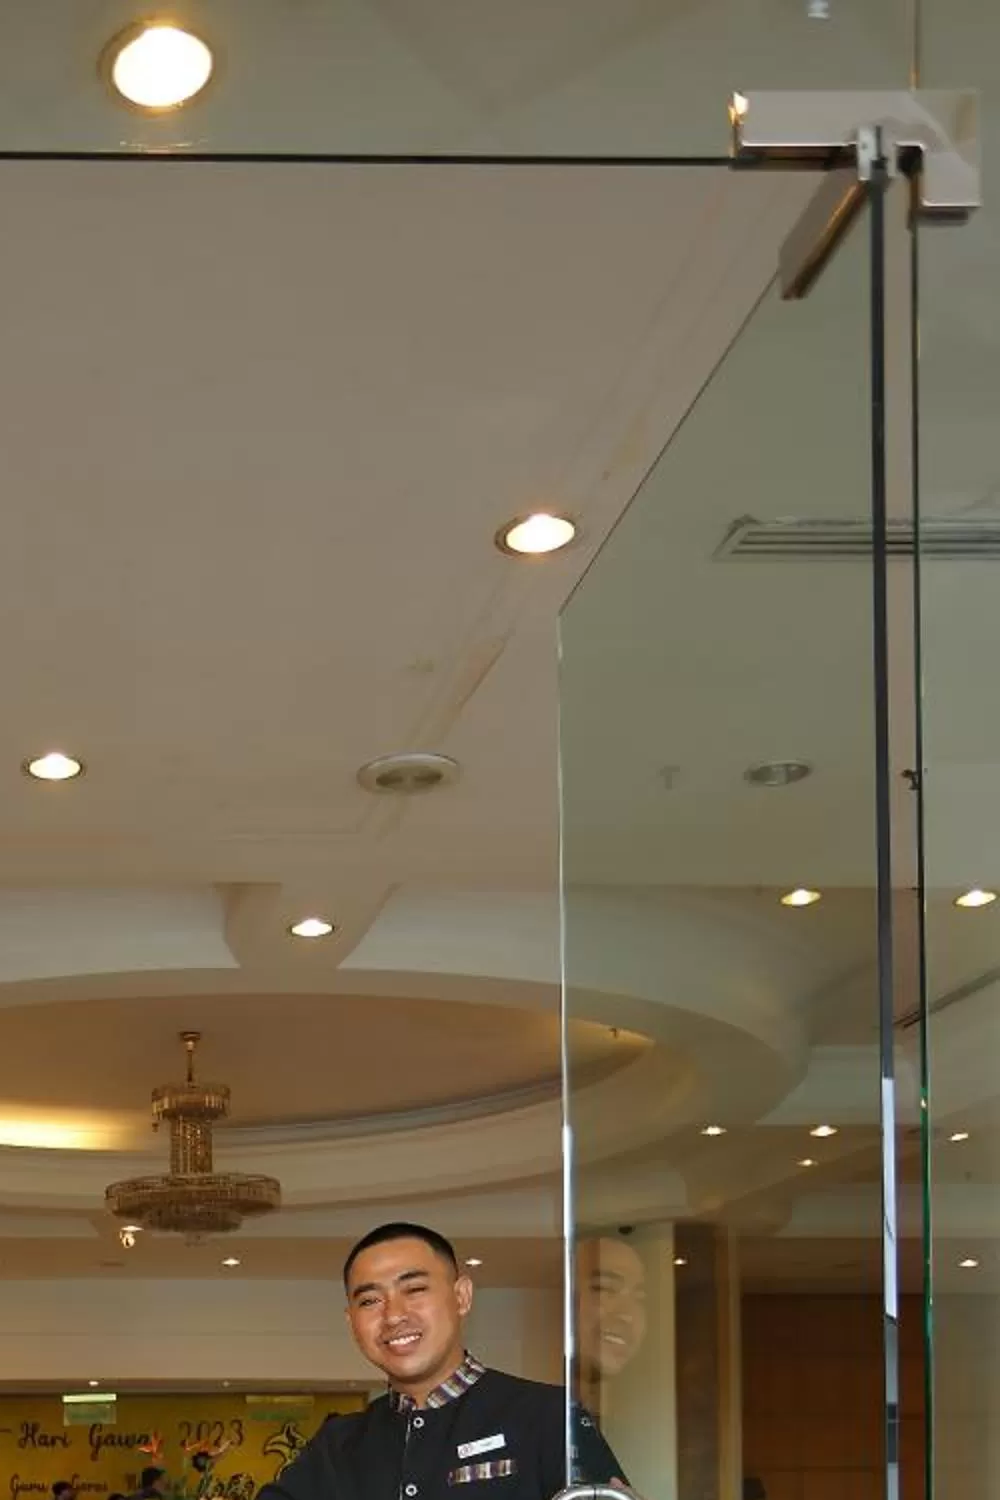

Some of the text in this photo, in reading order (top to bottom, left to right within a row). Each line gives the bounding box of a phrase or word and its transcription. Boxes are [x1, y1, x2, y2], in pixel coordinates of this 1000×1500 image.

[18, 1420, 72, 1448] Hari
[88, 1423, 164, 1461] Gawa
[179, 1419, 245, 1450] 2023
